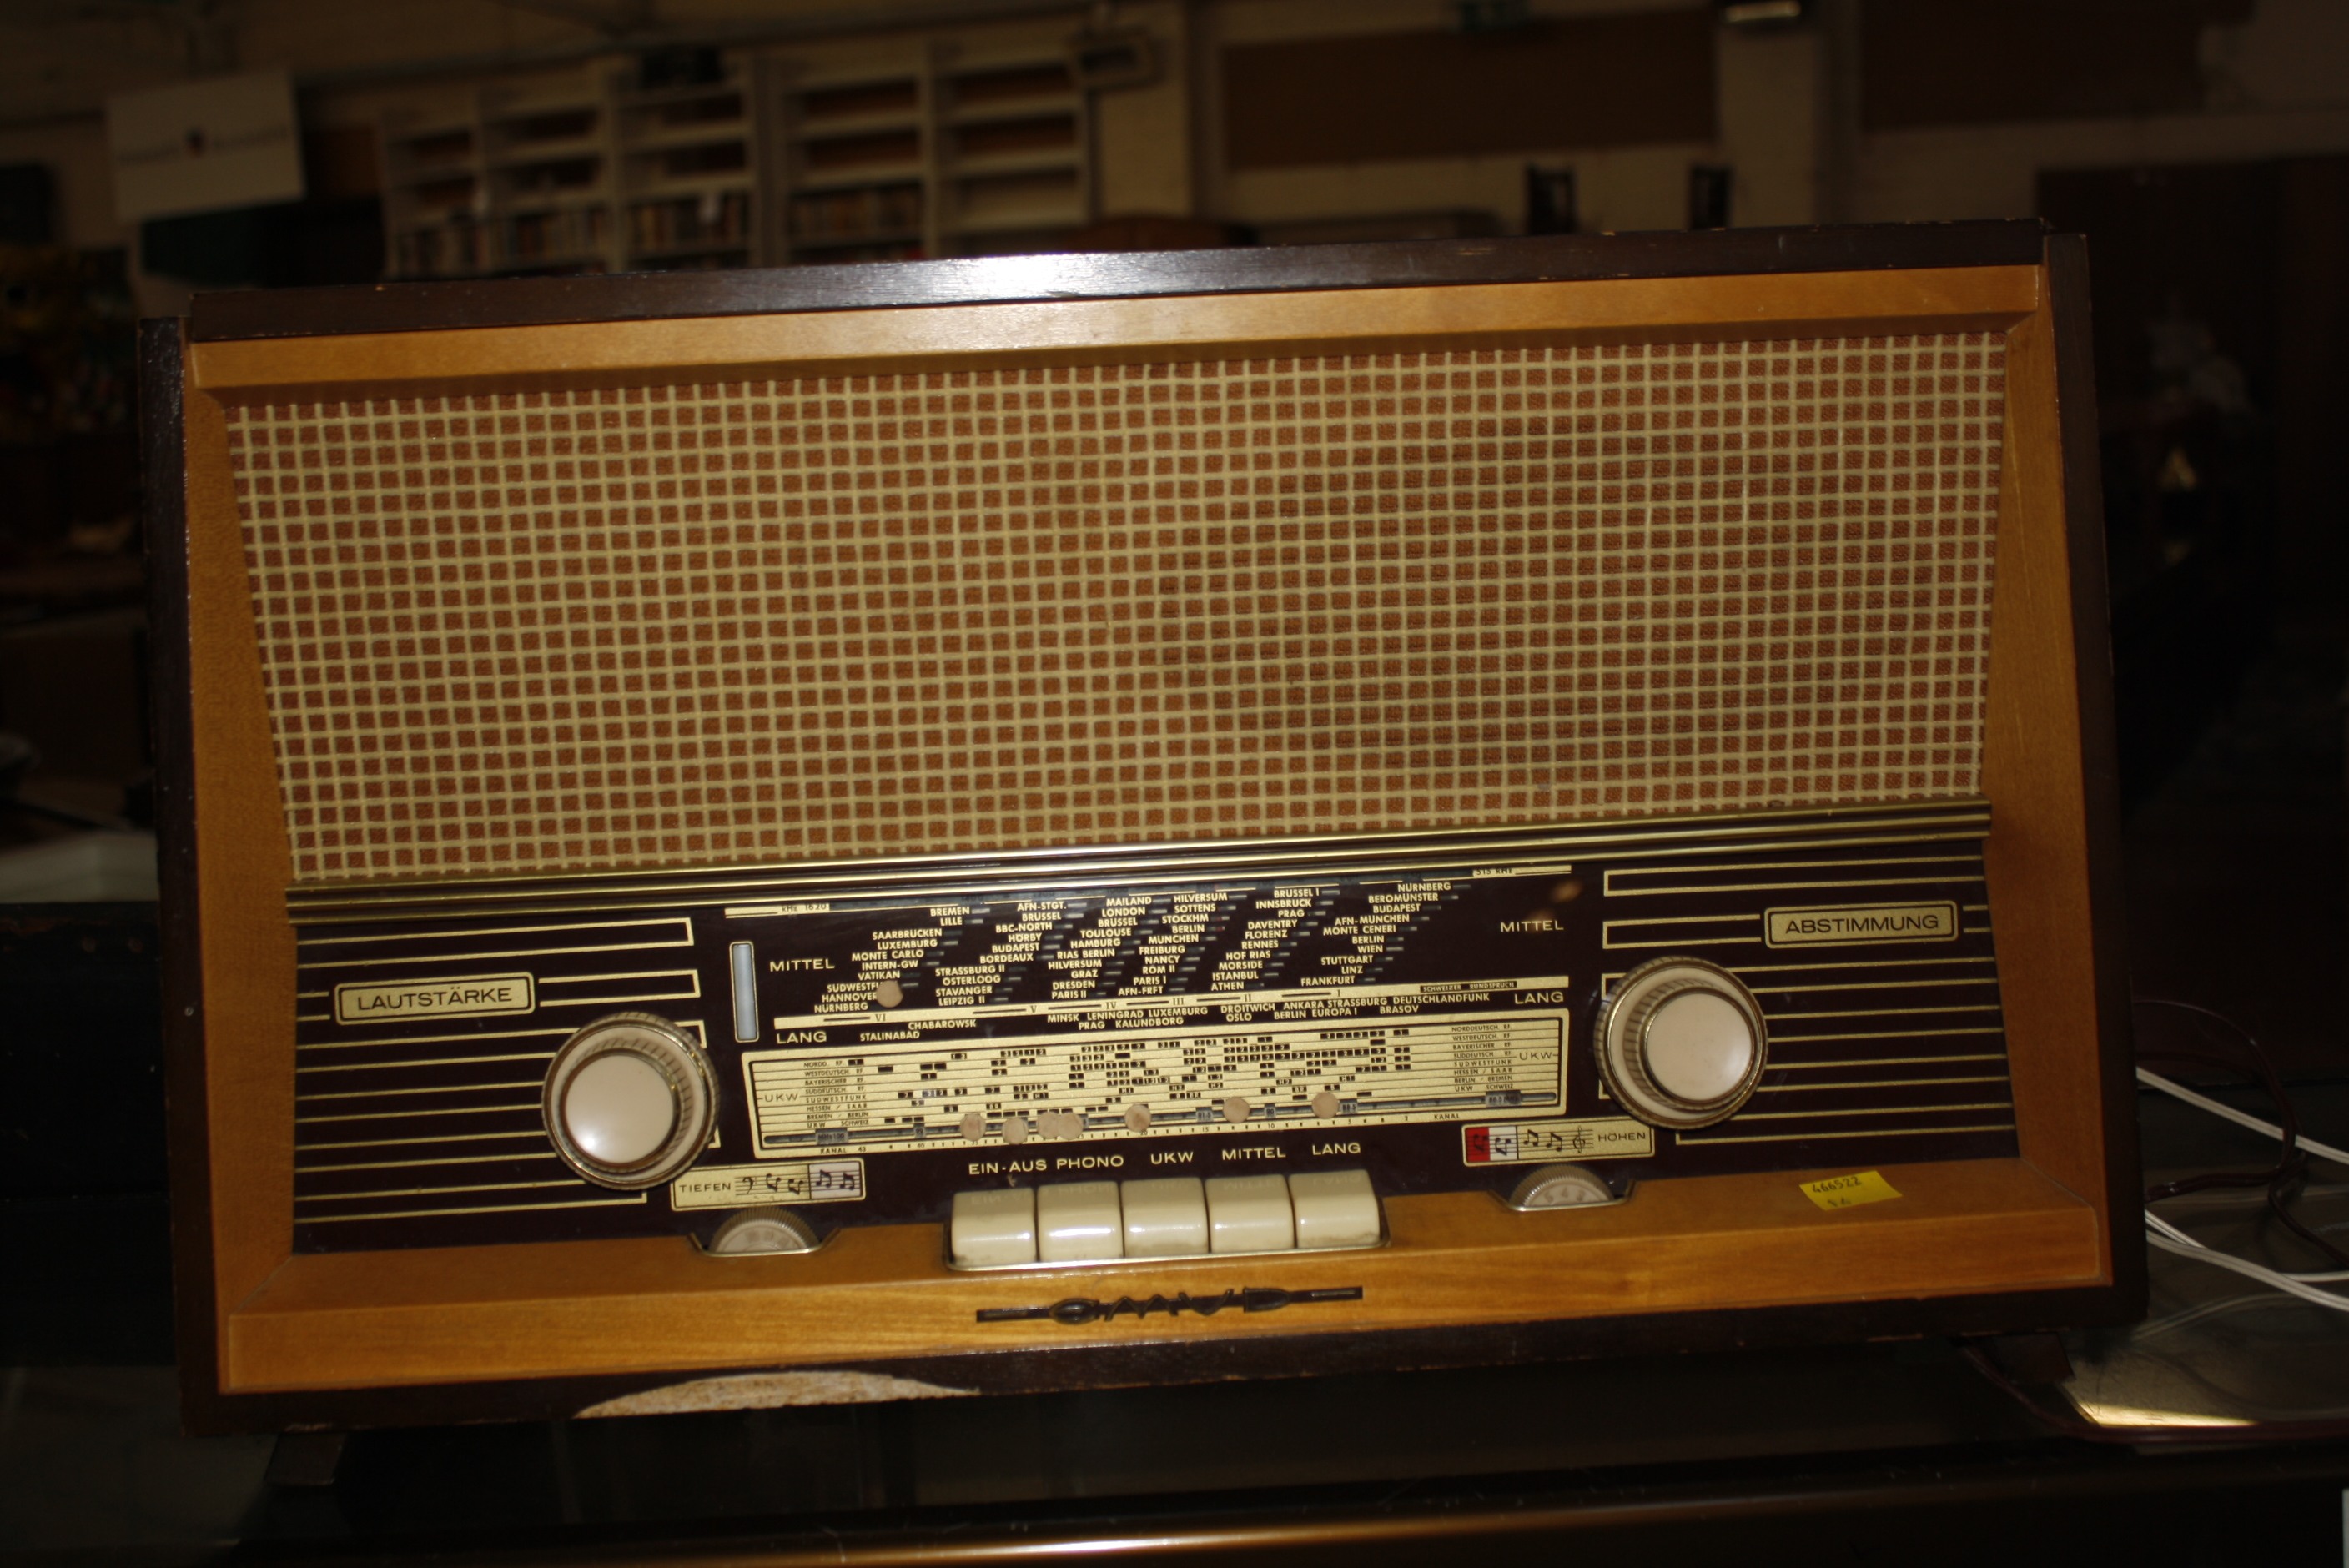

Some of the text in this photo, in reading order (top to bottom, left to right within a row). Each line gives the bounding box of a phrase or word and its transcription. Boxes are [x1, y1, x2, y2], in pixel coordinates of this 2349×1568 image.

[1106, 897, 1151, 907] MAILAND
[1174, 893, 1228, 903] HILVERSUM
[1174, 904, 1216, 913] SOTTENS
[1256, 899, 1311, 909] INNSBRUCK
[1373, 904, 1421, 914] BUDAPEST
[930, 907, 970, 917] BREMEN
[1102, 907, 1146, 917] LONDON
[1278, 909, 1305, 918] PRAG
[940, 917, 963, 927] LILLE
[1162, 914, 1209, 924] STOCKHM
[996, 922, 1053, 933] BBC-NORTH
[1172, 924, 1205, 934] BERLIN
[1248, 919, 1298, 930] DAVENTRY
[1500, 920, 1564, 932] MITTEL
[1786, 915, 1939, 934] ABSTIMMUNG
[1080, 928, 1131, 938] TOULOUSE
[1245, 930, 1288, 939] FLORENZ
[1323, 924, 1396, 936] MONTE CENERI
[878, 939, 938, 950] LUXEMBURG
[1070, 939, 1121, 949] HAMBURG
[1241, 940, 1278, 949] RENNES
[1351, 936, 1384, 944] BERLIN
[992, 942, 1039, 953] BUDAPEST
[1139, 946, 1185, 955] FREIBURG
[1358, 945, 1383, 954] WIEN
[852, 950, 924, 962] MONTE CARLO
[980, 953, 1034, 964] BORDEAUX
[1057, 949, 1115, 959] RIAS BERLIN
[1226, 951, 1271, 961] HOF RIAS
[770, 958, 835, 972] MITTEL
[1048, 959, 1102, 969] HILVERSUM
[1144, 956, 1180, 964] NANCY
[1321, 954, 1373, 966] STUTTGART
[862, 960, 918, 971] INTERN-GW
[1143, 965, 1166, 974] ROM
[1219, 961, 1263, 971] MORSIDE
[1341, 966, 1363, 974] LINZ
[858, 971, 901, 981] VATIKAN
[935, 966, 996, 977] STRASSBURG
[1071, 969, 1098, 978] GRAZ
[1212, 971, 1258, 981] ISTANBUL
[943, 975, 1001, 986] OSTERLOOG
[1053, 980, 1095, 990] DRESDEN
[1134, 977, 1160, 986] PARIS
[1301, 976, 1356, 987] FRANKFURT
[936, 986, 993, 997] STAVANGER
[1118, 986, 1163, 996] AFN-FRFT
[1211, 982, 1245, 991] ATHEN
[1423, 981, 1514, 993] SCHWEIZER RUNDSPRUCH
[357, 987, 512, 1011] LAUTSTÄRKE
[1052, 991, 1079, 999] PARIS
[1515, 991, 1563, 1004] LANG
[939, 997, 974, 1007] LEIPZIG
[1173, 998, 1185, 1006] III
[1221, 993, 1490, 1014] DROITWICH ANKARA STRASSBURG DEUTSCHLANDFUNK
[1048, 1008, 1208, 1023] MINSK LENINGRAD LUXEMBURG
[1226, 1013, 1252, 1022] OSLO
[1275, 1011, 1306, 1019] BERLIN
[1311, 1008, 1351, 1018] EUROPA
[1380, 1005, 1418, 1014] BRASOV
[908, 1019, 976, 1031] CHABAROWSK
[1079, 1018, 1184, 1030] PRAG KALUNDBORG
[777, 1031, 827, 1044] LANG
[860, 1032, 920, 1042] STALINABAD
[1520, 1052, 1552, 1061] UKW
[764, 1093, 797, 1103] UKW
[1598, 1132, 1646, 1143] HÖHEN
[1221, 1148, 1286, 1161] MITTEL
[1311, 1143, 1361, 1156] LANG
[1056, 1154, 1124, 1169] PHONO
[1150, 1151, 1194, 1165] UKW
[679, 1183, 731, 1193] TIEFEN
[1812, 1176, 1862, 1193] 466522
